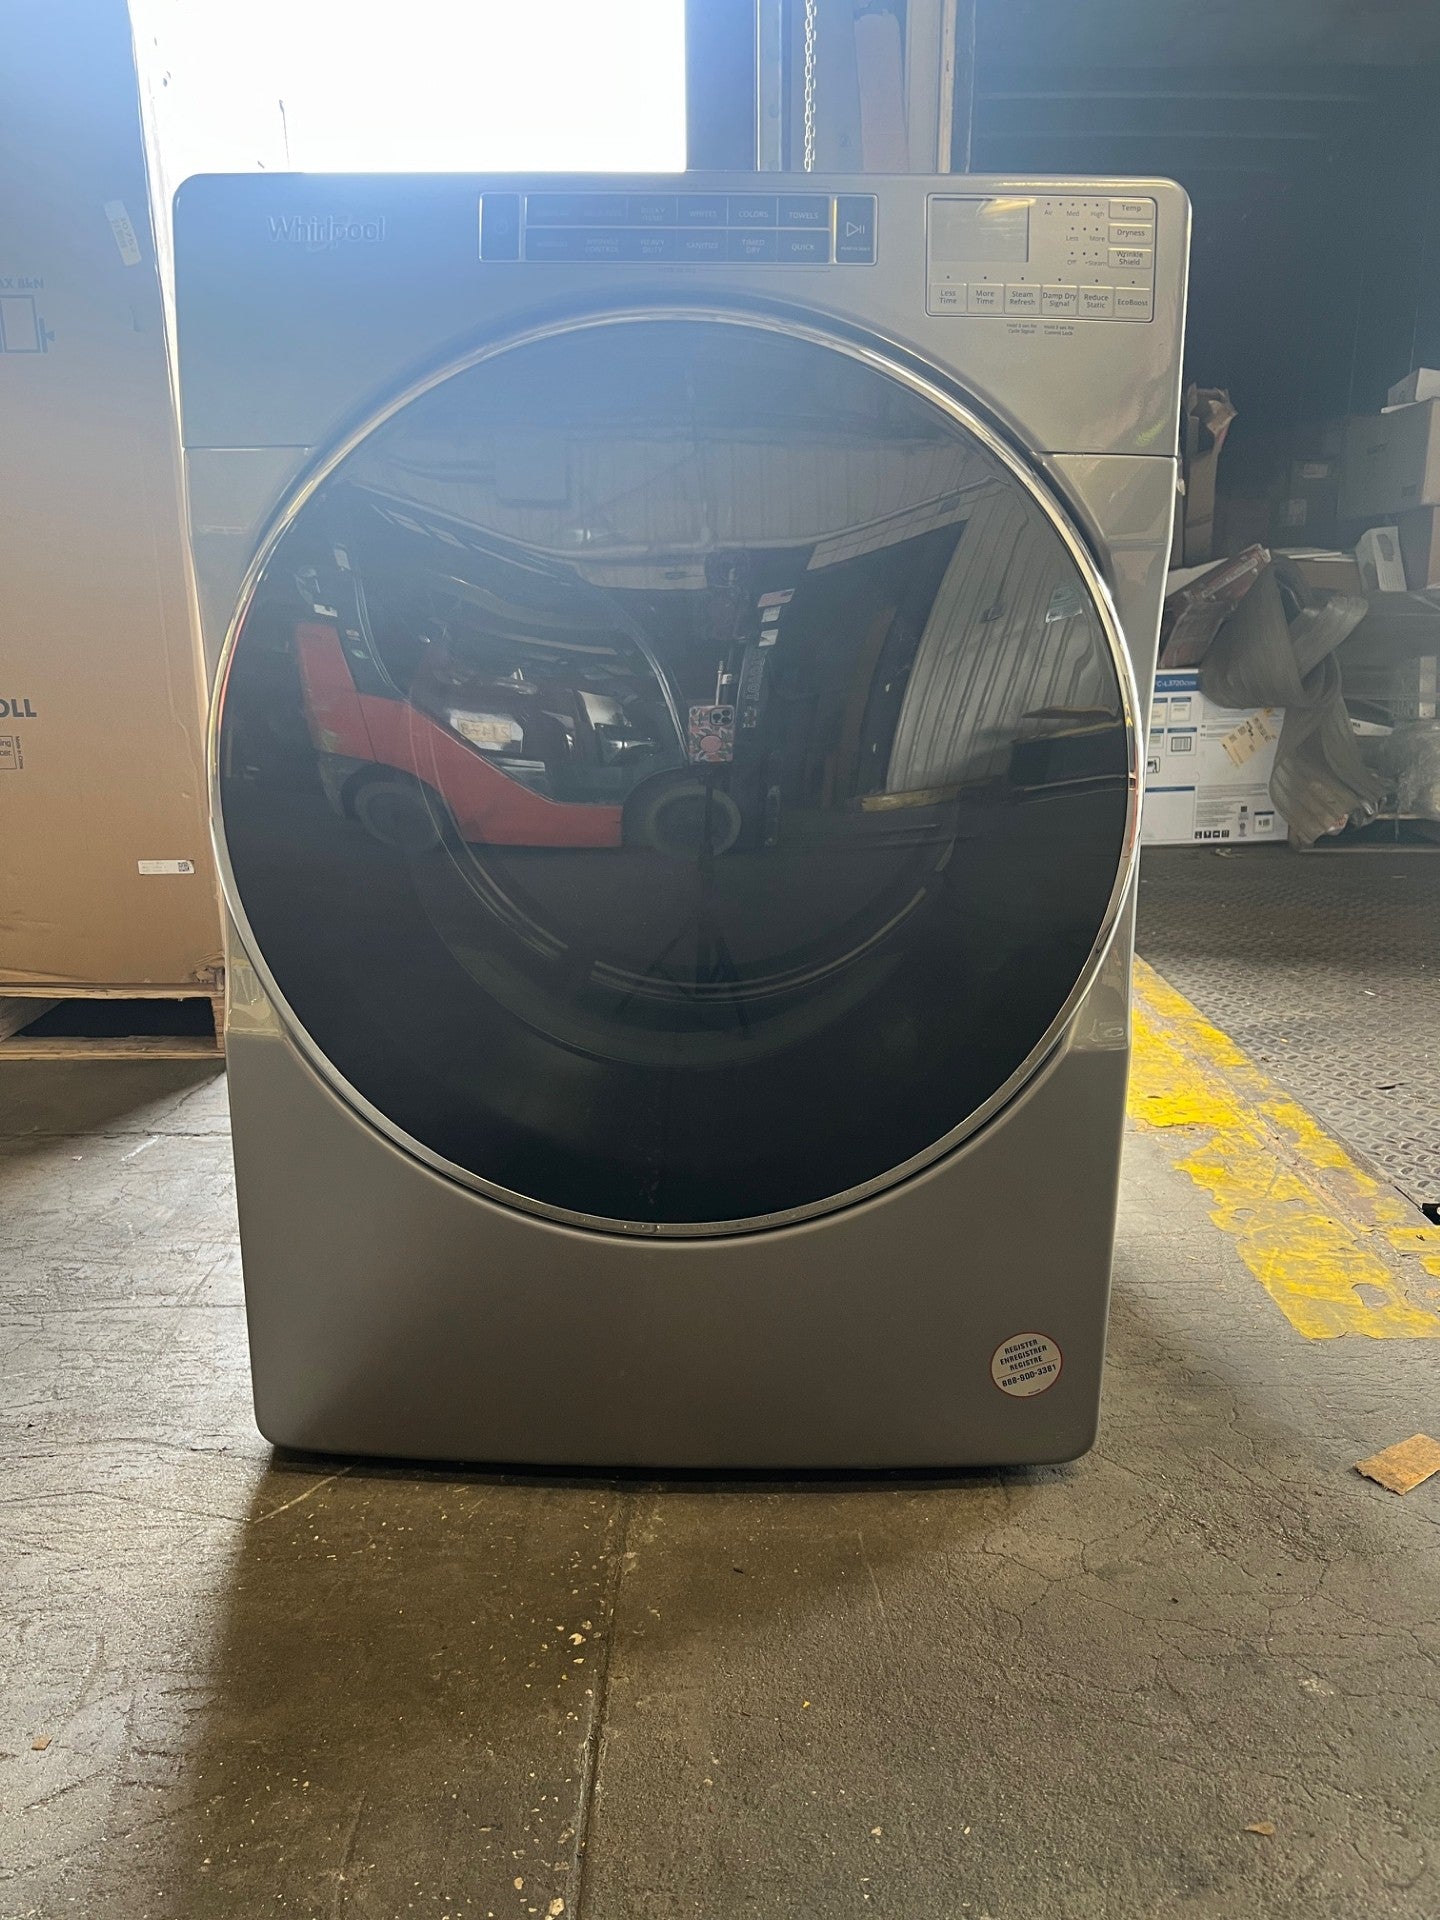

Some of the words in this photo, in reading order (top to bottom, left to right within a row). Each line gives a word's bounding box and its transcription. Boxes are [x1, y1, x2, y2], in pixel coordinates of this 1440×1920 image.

[1065, 209, 1080, 217] Med
[1121, 204, 1142, 213] Temp
[738, 210, 769, 218] COLORS
[788, 211, 819, 220] TOWELS
[1090, 210, 1105, 219] High
[265, 214, 387, 249] Whirlpool
[1116, 228, 1146, 238] Dryness
[741, 238, 766, 246] TIMED
[1065, 234, 1080, 242] Less
[1089, 235, 1106, 243] More
[745, 246, 761, 254] DRY
[791, 242, 816, 252] QUICK
[1116, 250, 1144, 259] Wrinkle
[1118, 257, 1144, 266] Shield
[940, 289, 957, 298] Less
[975, 289, 995, 298] More
[1011, 290, 1034, 299] Steam
[1042, 291, 1063, 302] Damp
[1064, 292, 1078, 303] Dry
[1083, 293, 1109, 302] Reduce
[938, 297, 958, 306] Time
[975, 297, 995, 306] Time
[1009, 297, 1036, 307] Refresh
[1049, 299, 1070, 309] Signal
[1086, 301, 1106, 310] Static
[1117, 298, 1149, 308] EcoBoost
[1004, 1339, 1038, 1355] REGISTER
[1000, 1345, 1048, 1365] ENREGISTRER
[1009, 1355, 1043, 1372] REGISTRE
